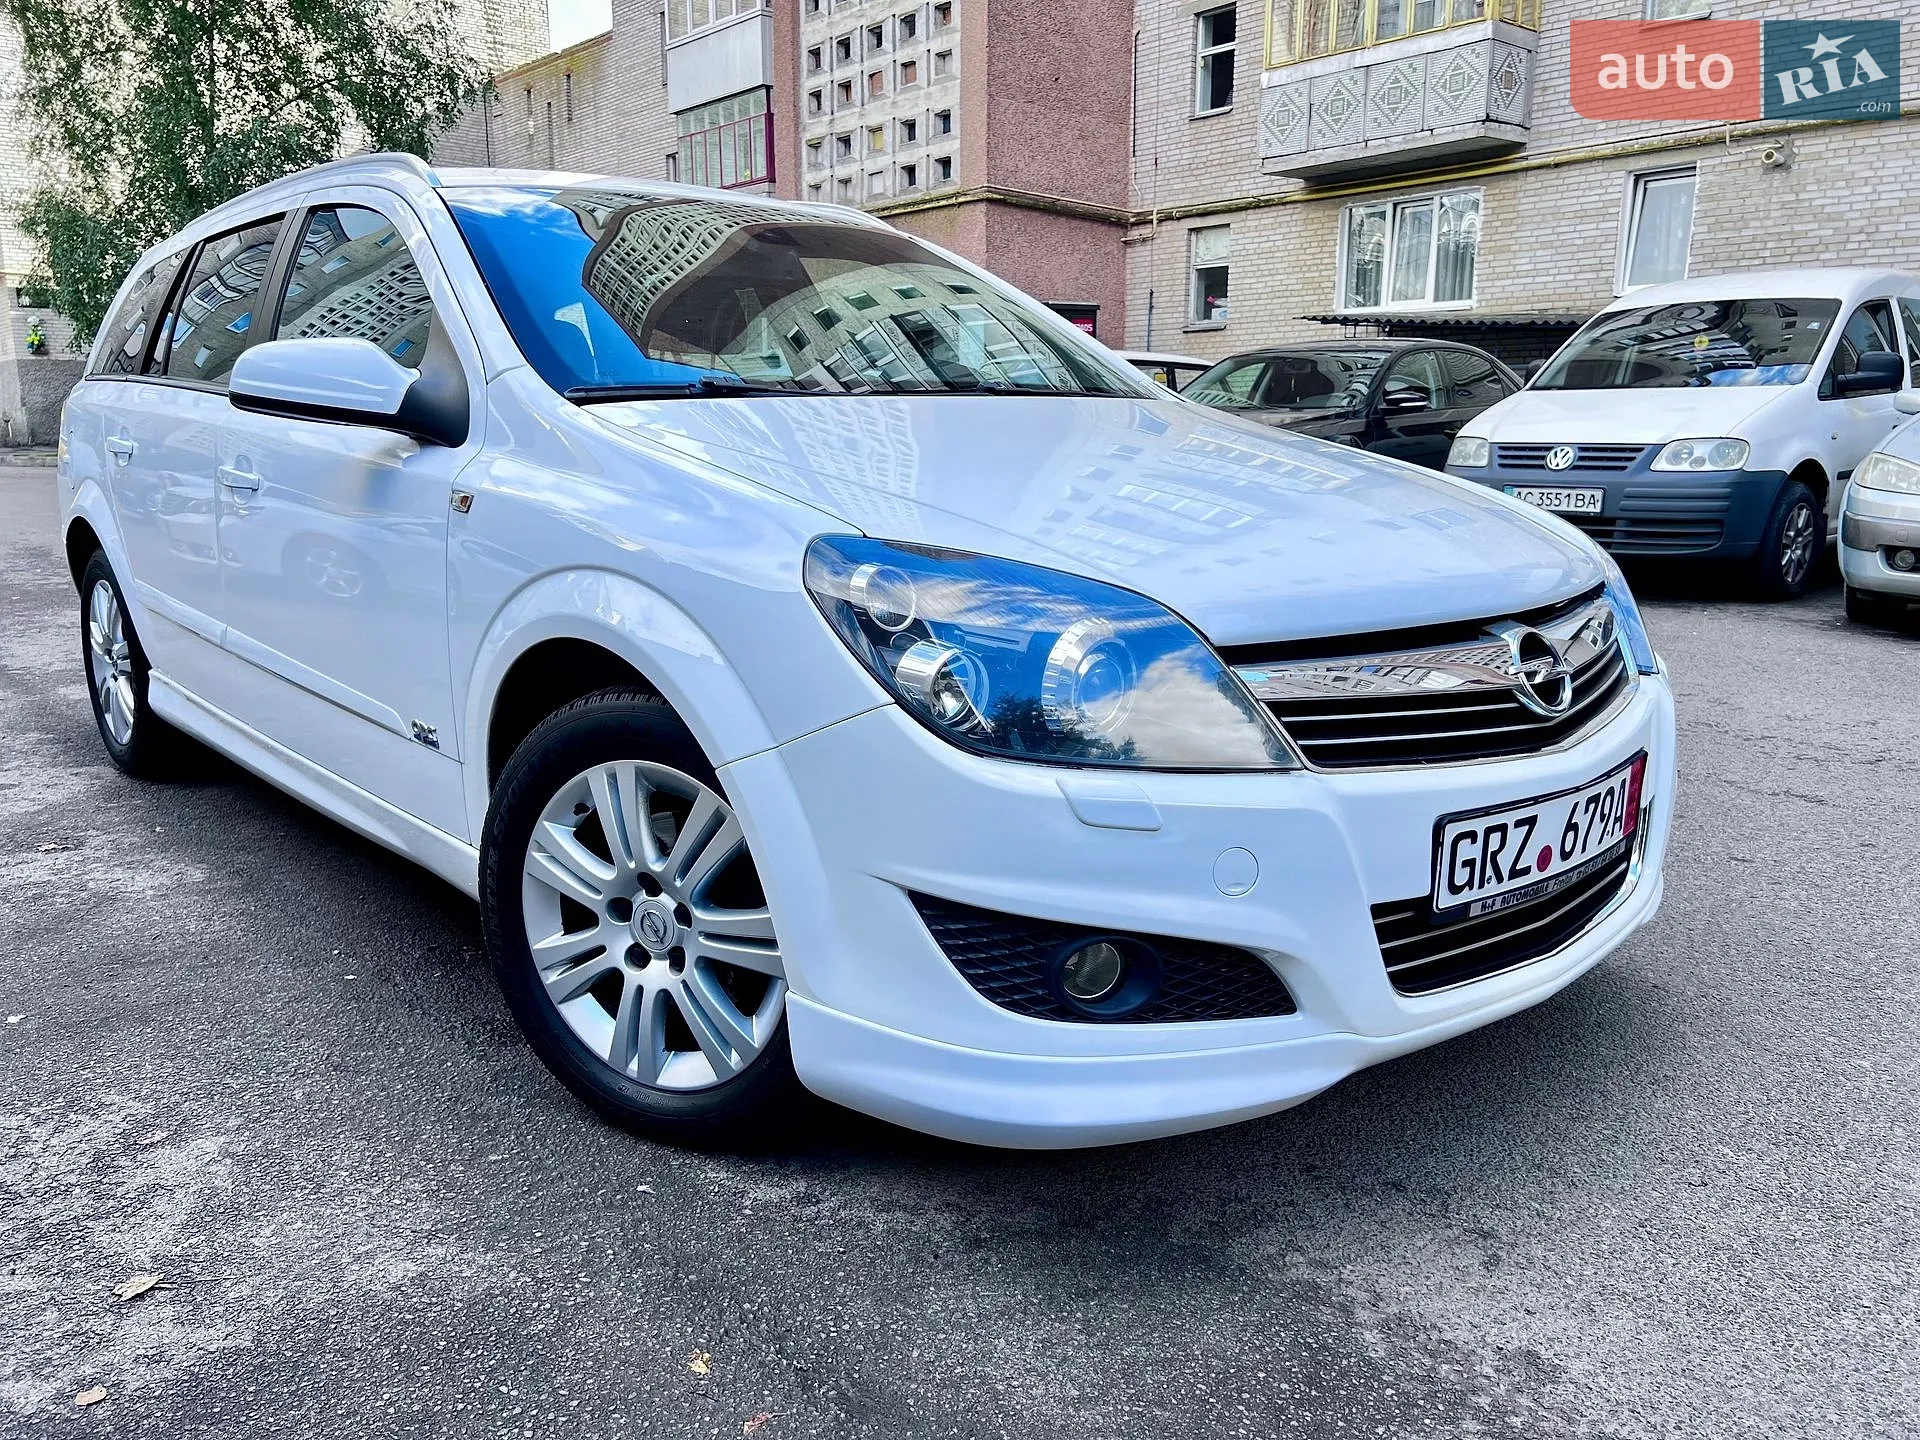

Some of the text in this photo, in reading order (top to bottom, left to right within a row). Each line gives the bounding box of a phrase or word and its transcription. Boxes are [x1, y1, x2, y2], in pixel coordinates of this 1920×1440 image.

[1536, 492, 1571, 507] 3551
[1575, 493, 1596, 509] BA
[1447, 814, 1538, 895] GRZ
[1560, 778, 1627, 862] 679A
[1500, 882, 1549, 907] AUTOMOBILE
